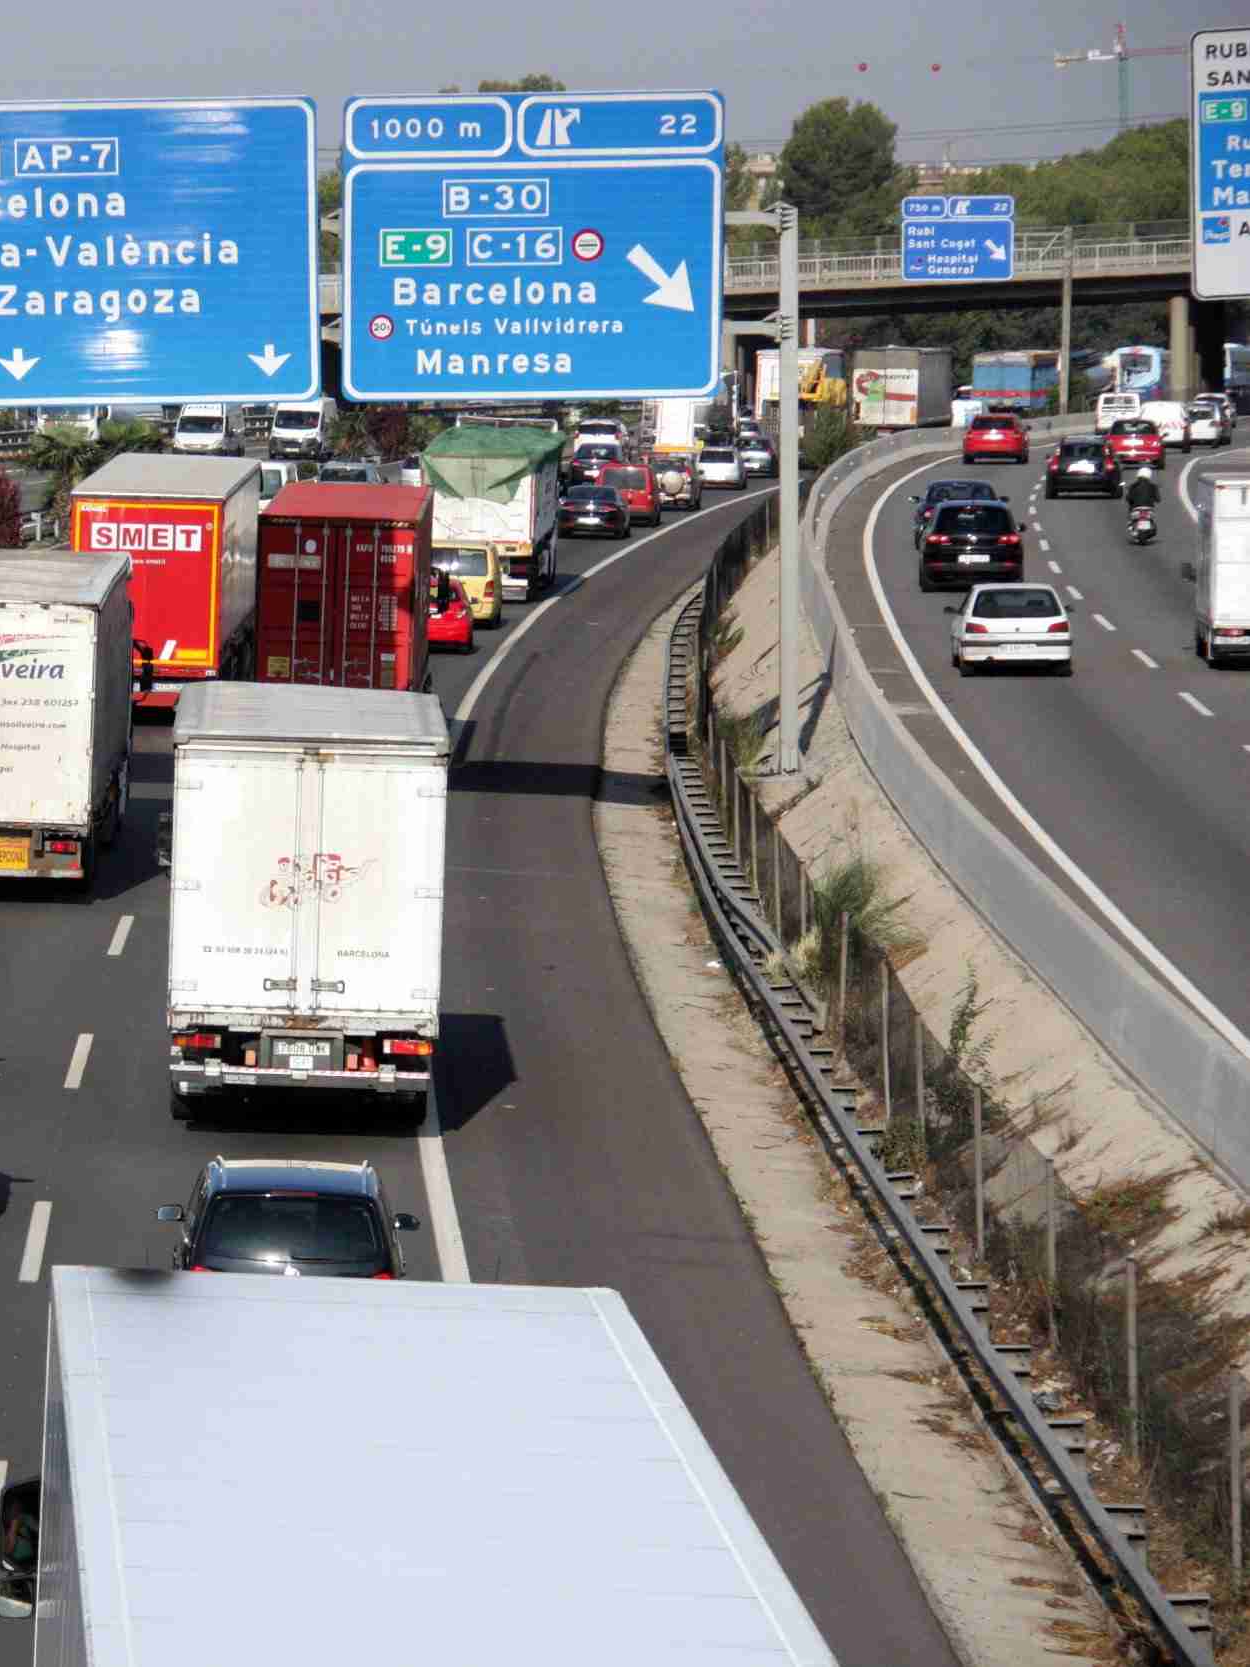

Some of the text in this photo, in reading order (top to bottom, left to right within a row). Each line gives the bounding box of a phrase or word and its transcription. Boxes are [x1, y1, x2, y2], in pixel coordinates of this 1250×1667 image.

[1205, 102, 1243, 119] E-9
[370, 118, 482, 139] 1000 m
[659, 114, 697, 135] 22
[21, 143, 112, 171] AP-7
[448, 184, 542, 212] B-30
[384, 235, 447, 261] E-9
[472, 234, 557, 260] C-16
[393, 277, 597, 306] Barcelona
[406, 317, 623, 336] Túnels Vallvidrera
[416, 349, 572, 375] Manresa
[95, 526, 199, 549] SMET
